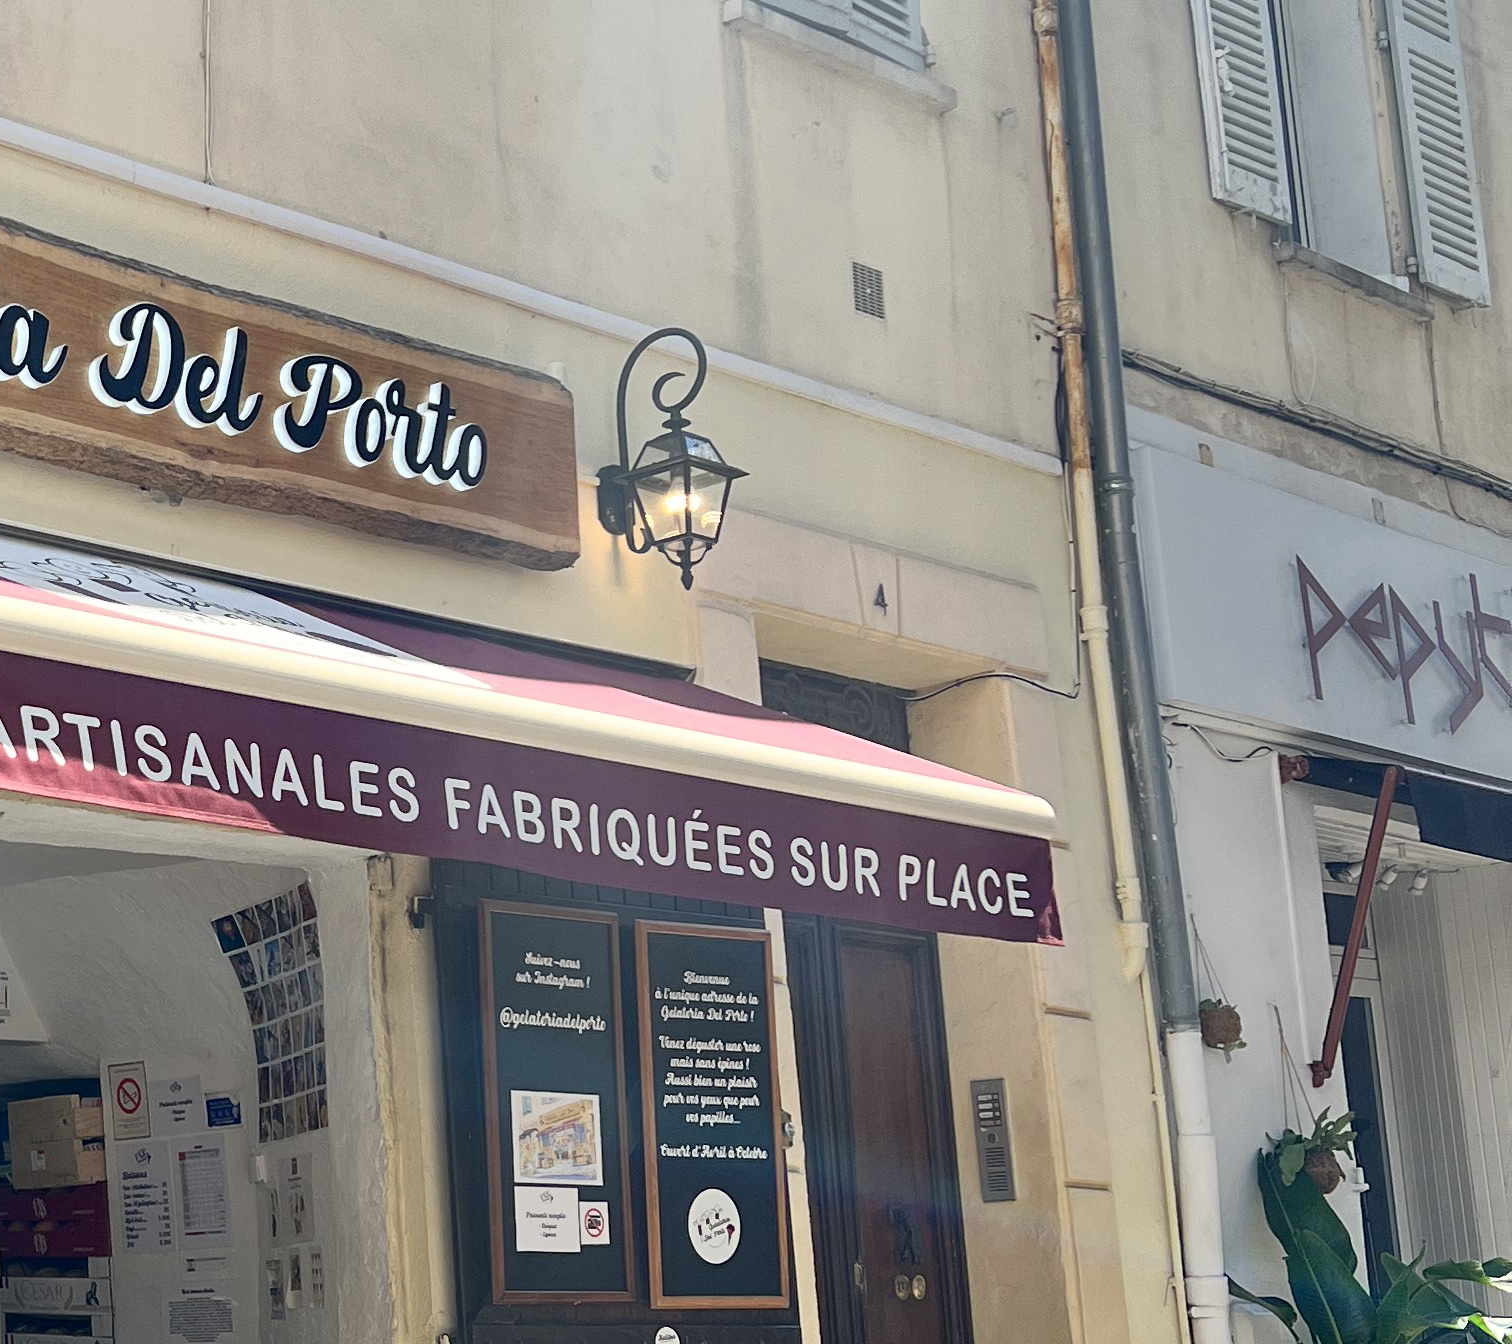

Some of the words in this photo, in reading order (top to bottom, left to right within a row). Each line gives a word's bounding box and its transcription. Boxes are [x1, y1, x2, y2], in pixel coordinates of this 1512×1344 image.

[88, 301, 263, 437] Del
[273, 354, 489, 492] Porto
[873, 583, 888, 616] 4
[443, 776, 775, 881] FABRIQUÉES
[789, 835, 881, 899] SUR
[897, 853, 1035, 919] PLACE
[515, 971, 532, 983] sur
[534, 970, 585, 990] Instagram
[683, 970, 730, 985] Bienvenue
[701, 990, 735, 1004] adresse
[735, 992, 748, 1004] de
[748, 992, 759, 1005] la
[499, 1006, 606, 1034] @gelateriadelporto
[660, 1005, 705, 1022] Gelateria
[706, 1007, 723, 1021] Del
[724, 1008, 748, 1022] Porto
[658, 1035, 685, 1049] Venez
[725, 1041, 743, 1052] une
[743, 1041, 762, 1053] rose
[670, 1056, 694, 1067] mais
[695, 1059, 716, 1068] sans
[665, 1072, 693, 1086] Aussi
[693, 1074, 713, 1086] bien
[714, 1078, 727, 1087] un
[727, 1075, 758, 1091] plaisir
[663, 1092, 685, 1107] pour
[686, 1094, 699, 1104] vos
[700, 1095, 722, 1108] yeux
[723, 1096, 739, 1109] que
[739, 1094, 761, 1109] pour
[685, 1113, 699, 1123] vos
